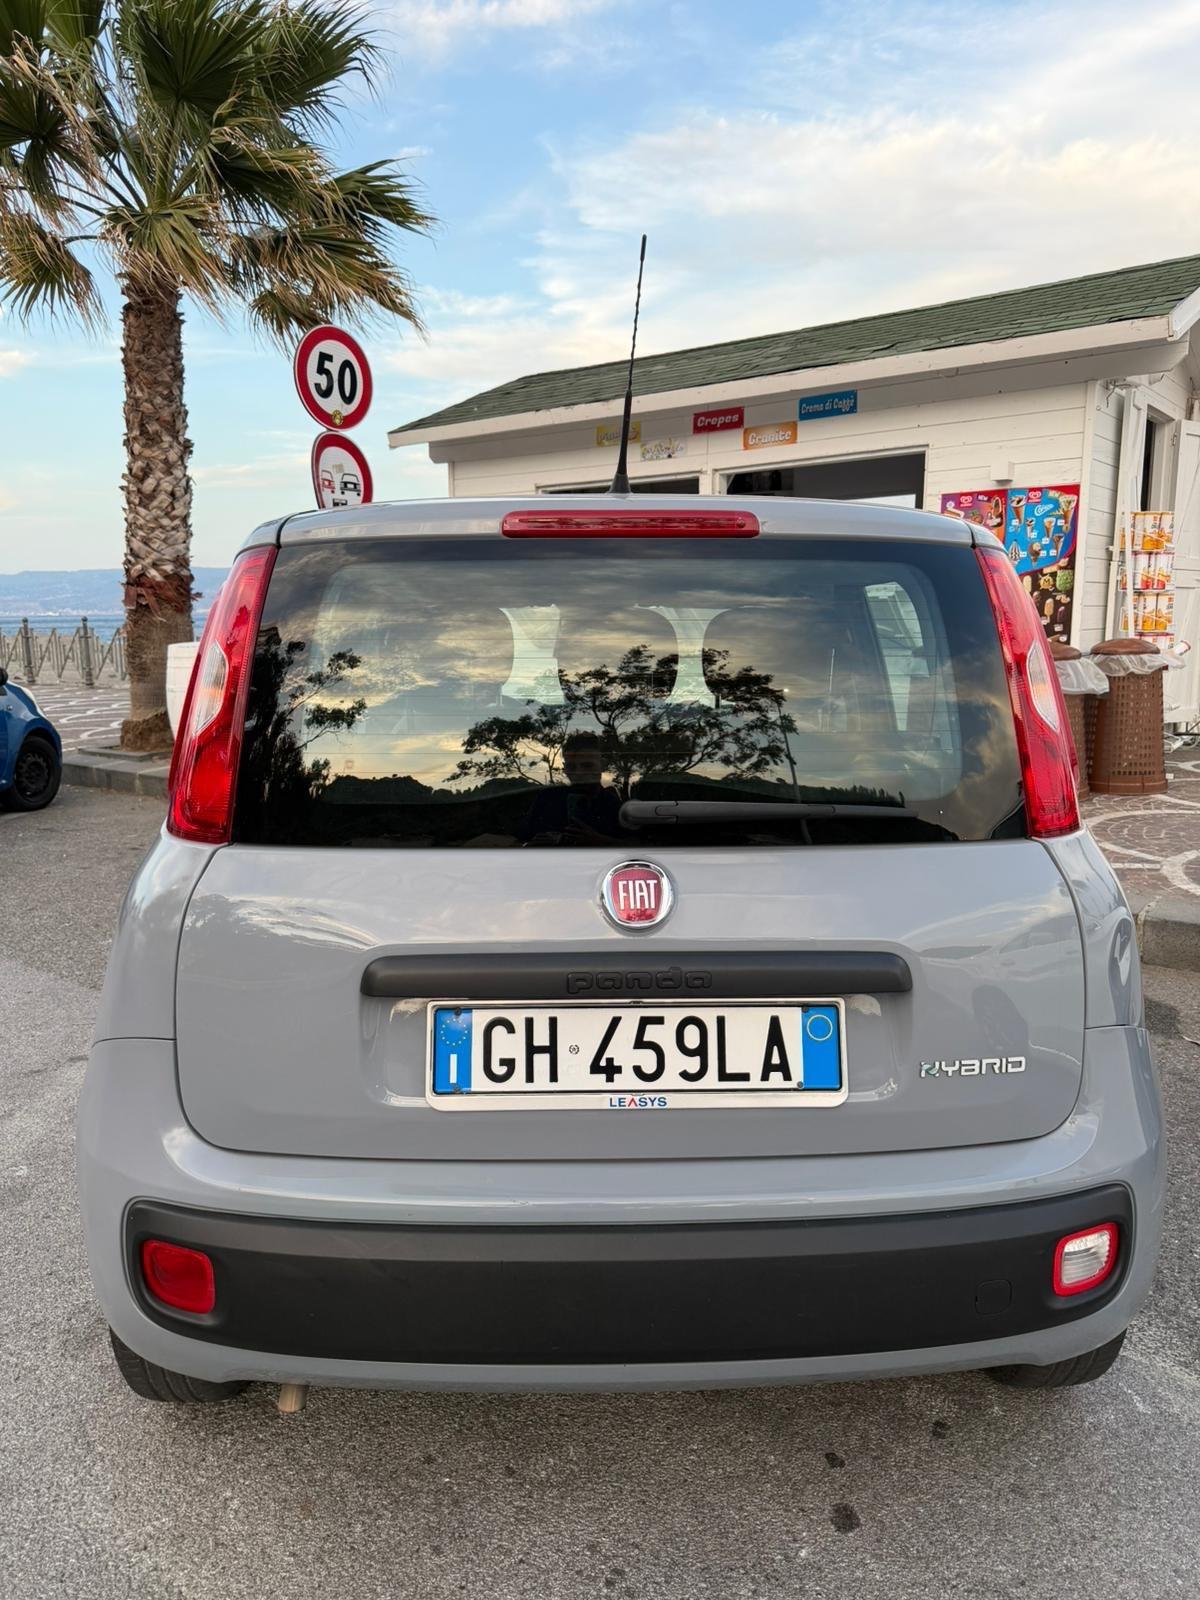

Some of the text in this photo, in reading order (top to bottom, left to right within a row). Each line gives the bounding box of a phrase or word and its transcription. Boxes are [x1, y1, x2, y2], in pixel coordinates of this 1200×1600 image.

[314, 351, 357, 405] 50
[801, 403, 824, 414] Crema
[825, 399, 833, 410] di
[697, 412, 739, 427] Crepes
[748, 430, 792, 445] Granite
[618, 879, 658, 910] FIAT
[567, 967, 713, 994] panda
[482, 1015, 793, 1083] GH 459LA
[920, 1056, 1026, 1077] HYBRID
[609, 1097, 667, 1107] LEASYS
